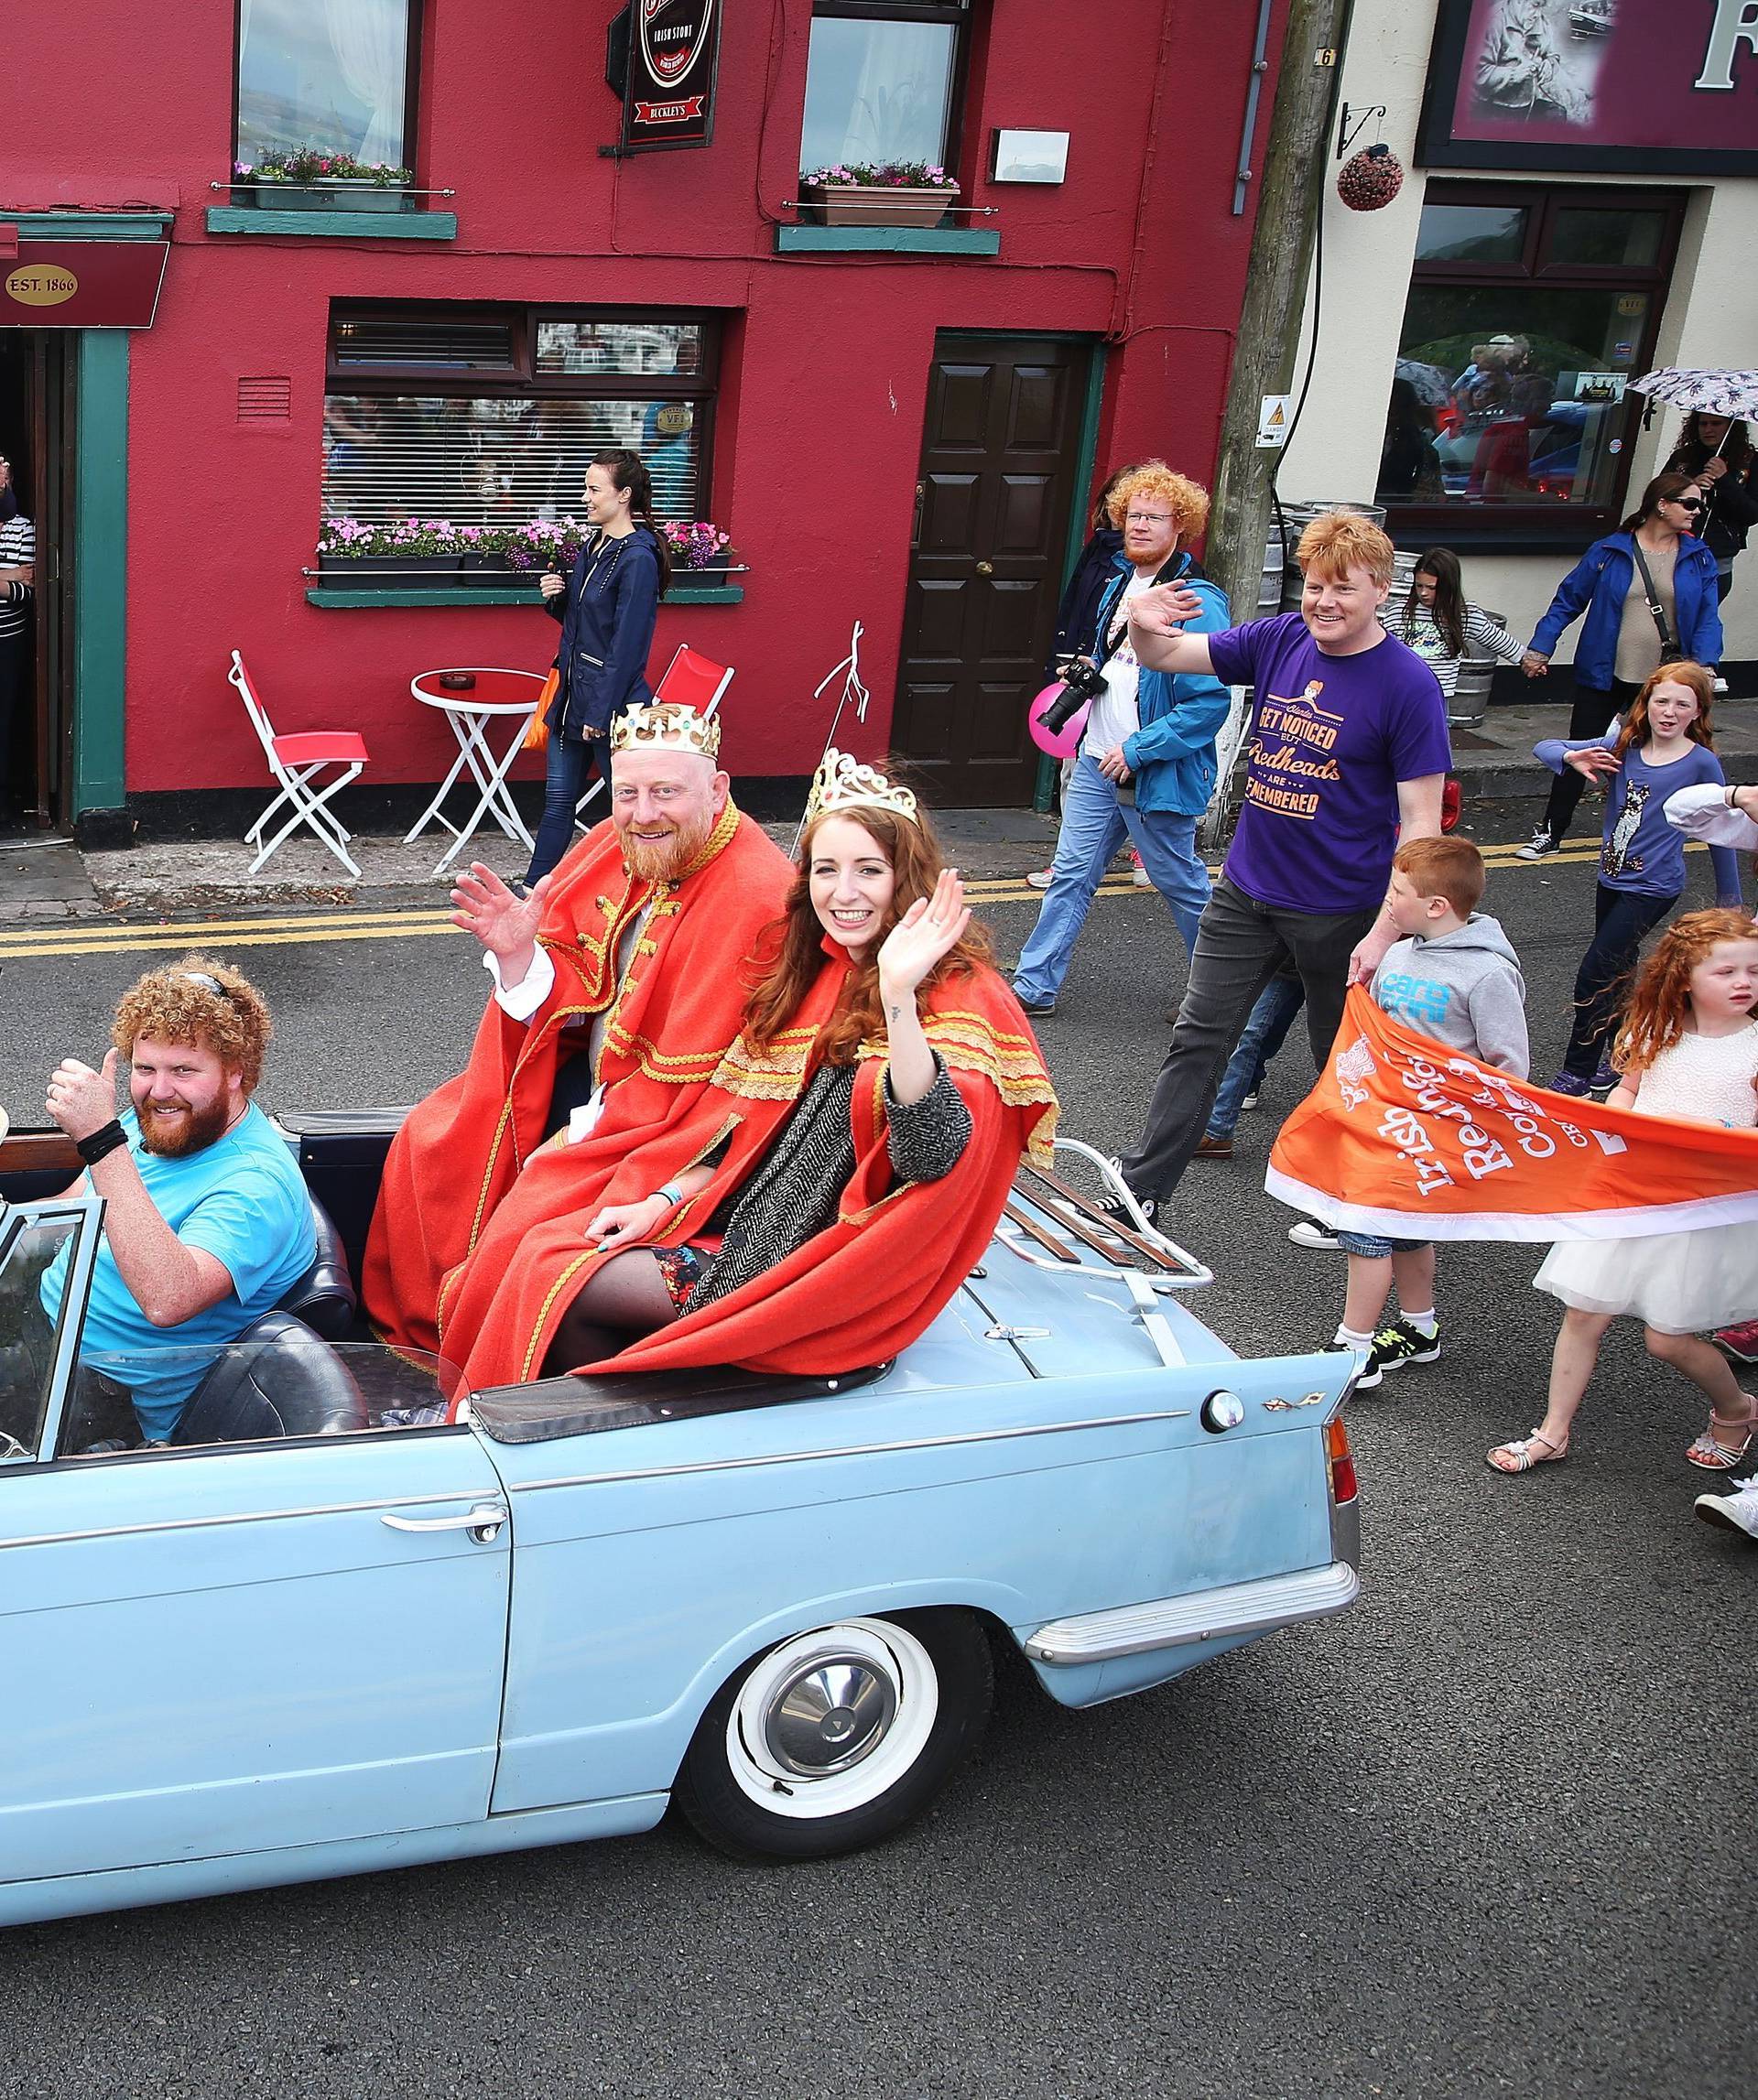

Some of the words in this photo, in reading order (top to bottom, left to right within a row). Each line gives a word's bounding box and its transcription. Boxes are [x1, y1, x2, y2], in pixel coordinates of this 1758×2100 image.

[654, 28, 671, 42] IRISH
[672, 24, 693, 39] STOUT
[1321, 49, 1332, 65] 6
[650, 105, 686, 118] BUCKLEY'S
[10, 278, 41, 291] EST.
[47, 278, 74, 291] 1866
[1259, 706, 1282, 729] GET
[1279, 712, 1338, 750] NOTICED
[1280, 732, 1302, 745] BUT
[1249, 737, 1340, 780] Redheads
[1267, 774, 1287, 786] ARE
[1376, 1107, 1456, 1196] Irish
